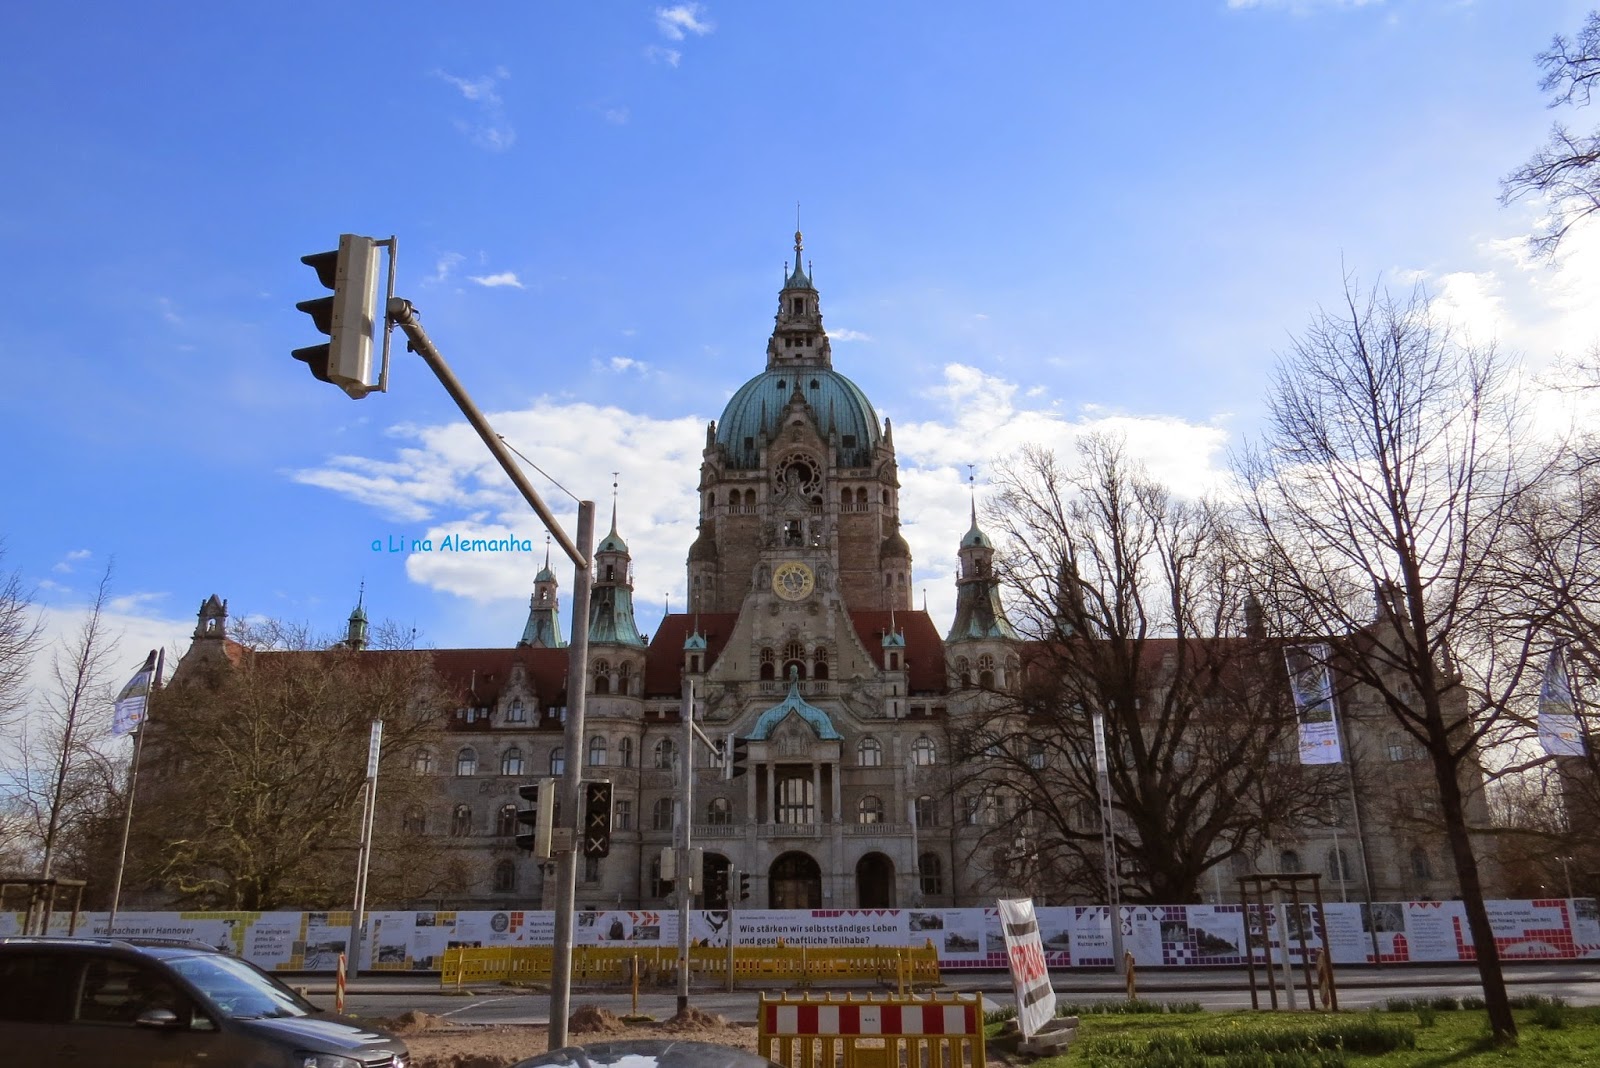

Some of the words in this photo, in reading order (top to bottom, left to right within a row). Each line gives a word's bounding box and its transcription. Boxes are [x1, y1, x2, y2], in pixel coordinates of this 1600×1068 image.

[93, 927, 108, 935] Wie
[142, 927, 154, 935] wir
[156, 927, 195, 935] Hannover
[739, 924, 755, 933] Wie
[756, 924, 788, 933] stärken
[790, 924, 802, 933] wir
[804, 924, 871, 934] selbstständiges
[872, 924, 898, 933] Leben
[739, 936, 755, 945] und
[756, 936, 828, 946] geselschaftliche
[830, 936, 870, 945] Teilhabe?
